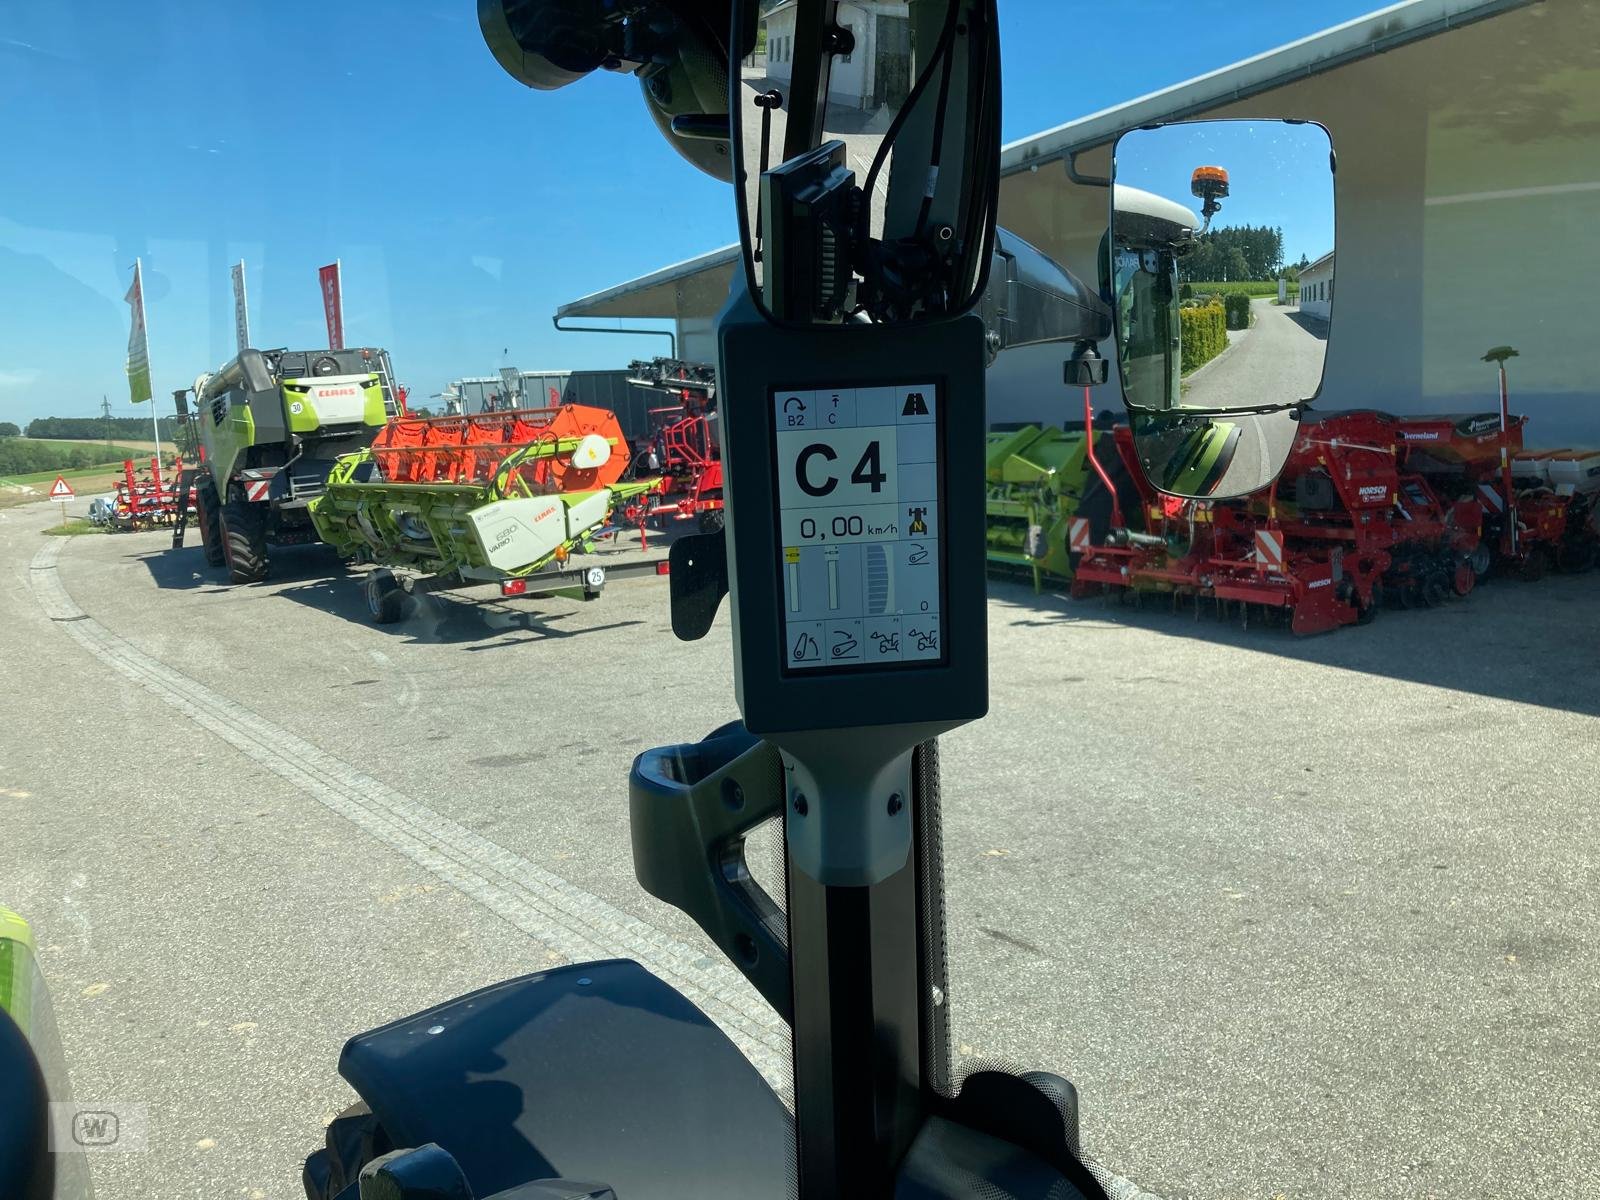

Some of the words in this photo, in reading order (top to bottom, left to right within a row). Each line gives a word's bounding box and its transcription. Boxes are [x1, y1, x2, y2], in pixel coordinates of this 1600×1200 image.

[318, 388, 356, 397] CLAAS
[292, 403, 301, 413] 30
[788, 414, 805, 426] B2
[828, 413, 837, 424] C
[534, 506, 556, 523] CLAAS
[801, 515, 863, 541] 0,00
[867, 523, 898, 535] km/h
[914, 521, 923, 532] N
[497, 525, 518, 541] 680
[489, 538, 510, 553] VARIO
[591, 571, 602, 583] 25
[920, 600, 928, 611] 0
